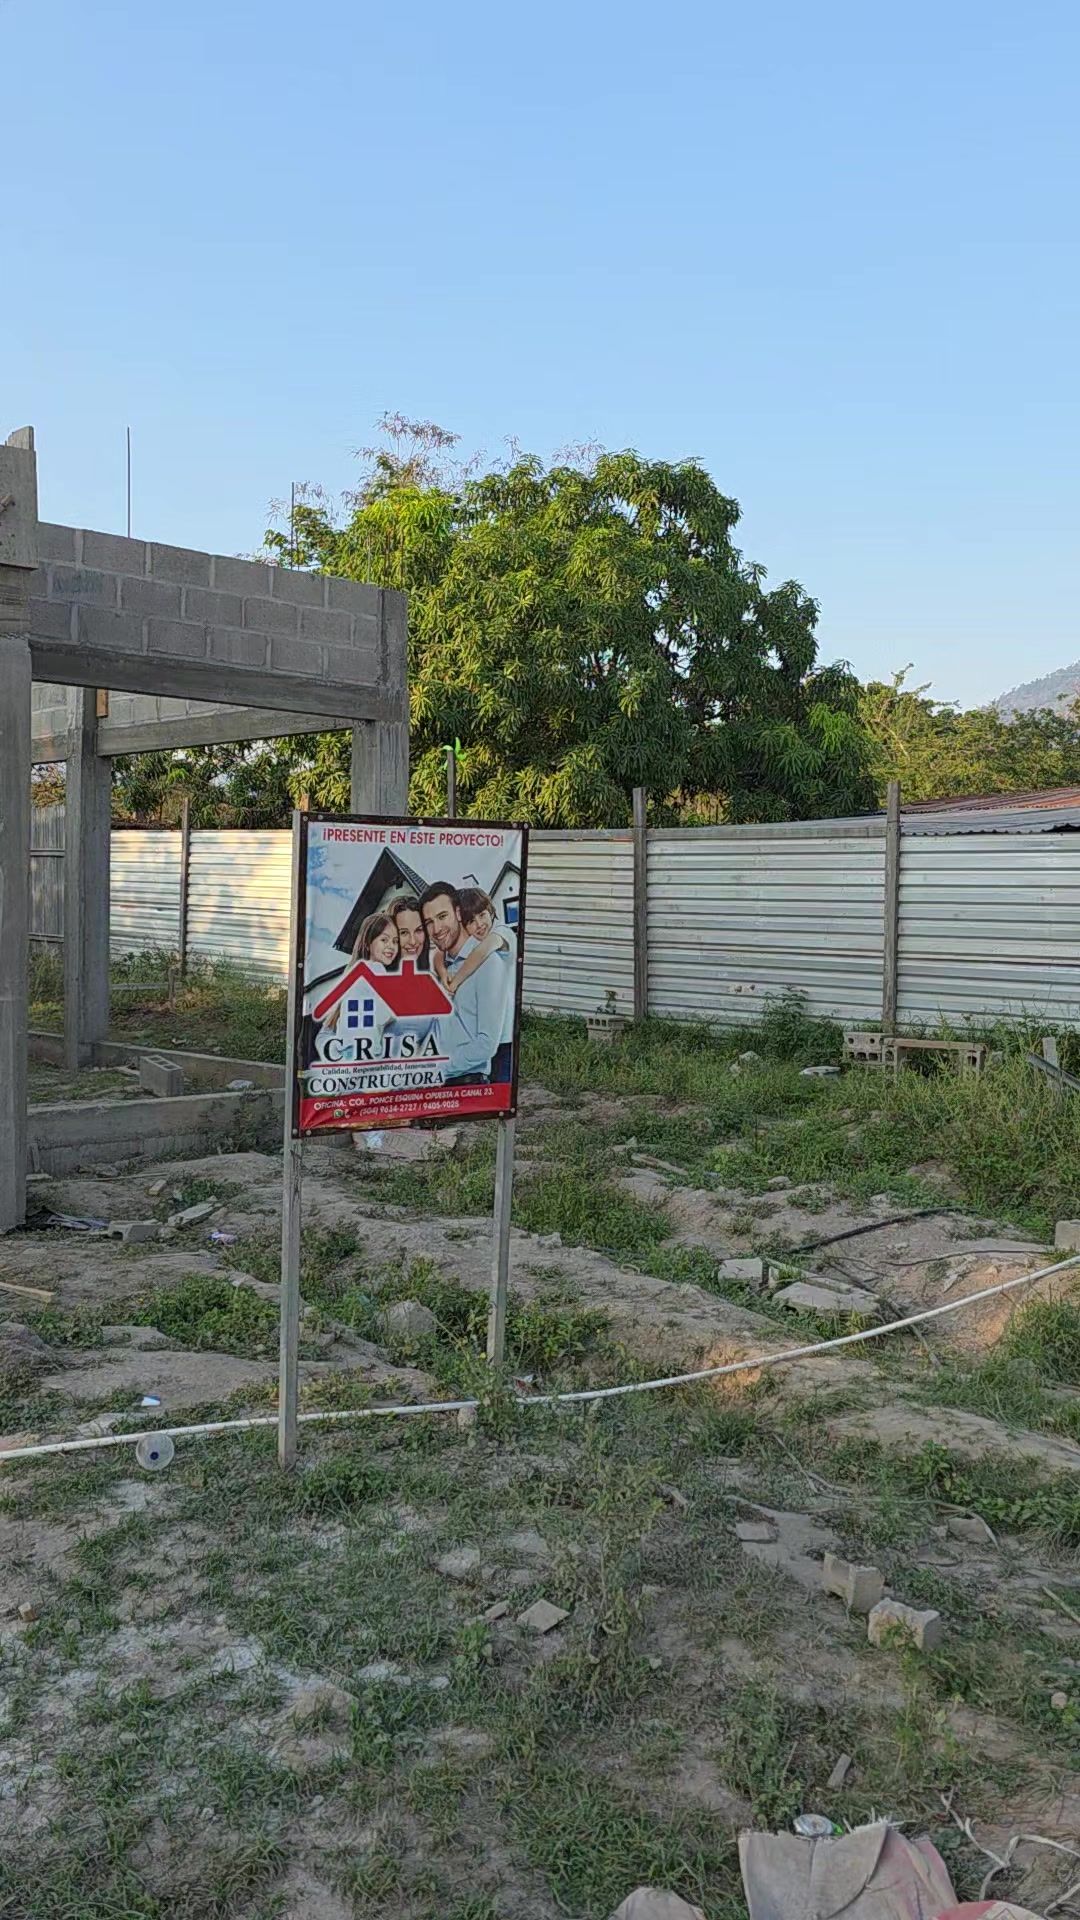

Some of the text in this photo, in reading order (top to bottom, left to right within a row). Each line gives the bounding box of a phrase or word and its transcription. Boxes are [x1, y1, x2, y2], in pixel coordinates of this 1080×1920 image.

[390, 831, 406, 844] EN
[409, 832, 435, 845] ESTE
[439, 833, 504, 847] PROYECTO!
[323, 1034, 440, 1062] CRISA
[310, 1071, 443, 1093] CONSTRUCTORA
[313, 1100, 346, 1110] OFICINA:
[369, 1095, 393, 1104] PONCE
[394, 1093, 424, 1103] ESQUINA
[425, 1090, 453, 1099] OPUESTA
[454, 1090, 460, 1098] A
[460, 1089, 482, 1098] CANAL
[380, 1103, 417, 1114] 9634-2727
